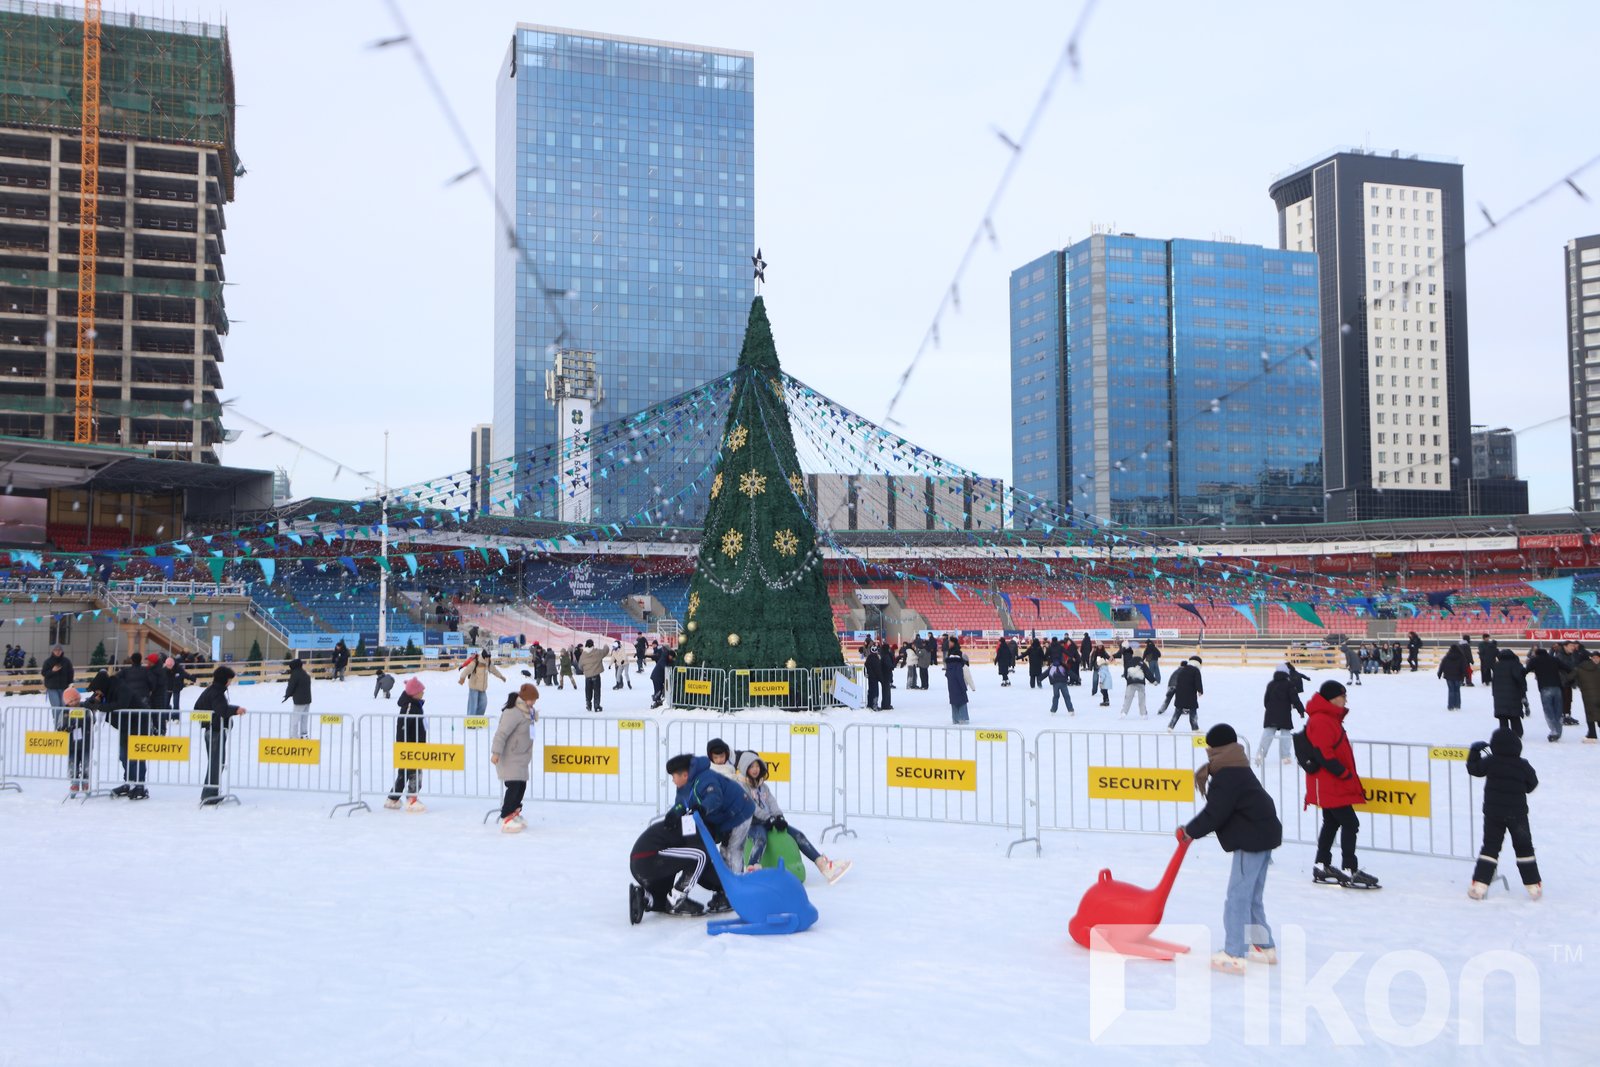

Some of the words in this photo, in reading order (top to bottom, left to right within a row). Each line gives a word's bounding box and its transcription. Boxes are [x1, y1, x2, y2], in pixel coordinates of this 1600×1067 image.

[568, 580, 595, 589] Winter
[29, 737, 64, 748] SECURITY
[134, 743, 183, 753] SECURITY
[264, 746, 313, 757] SECURITY
[400, 751, 456, 762] SECURITY
[1433, 749, 1464, 757] C-0925
[551, 754, 611, 765] SECURITY
[896, 766, 965, 780] SECURITY
[1098, 777, 1181, 791] SECURITY
[1364, 789, 1416, 805] URITY
